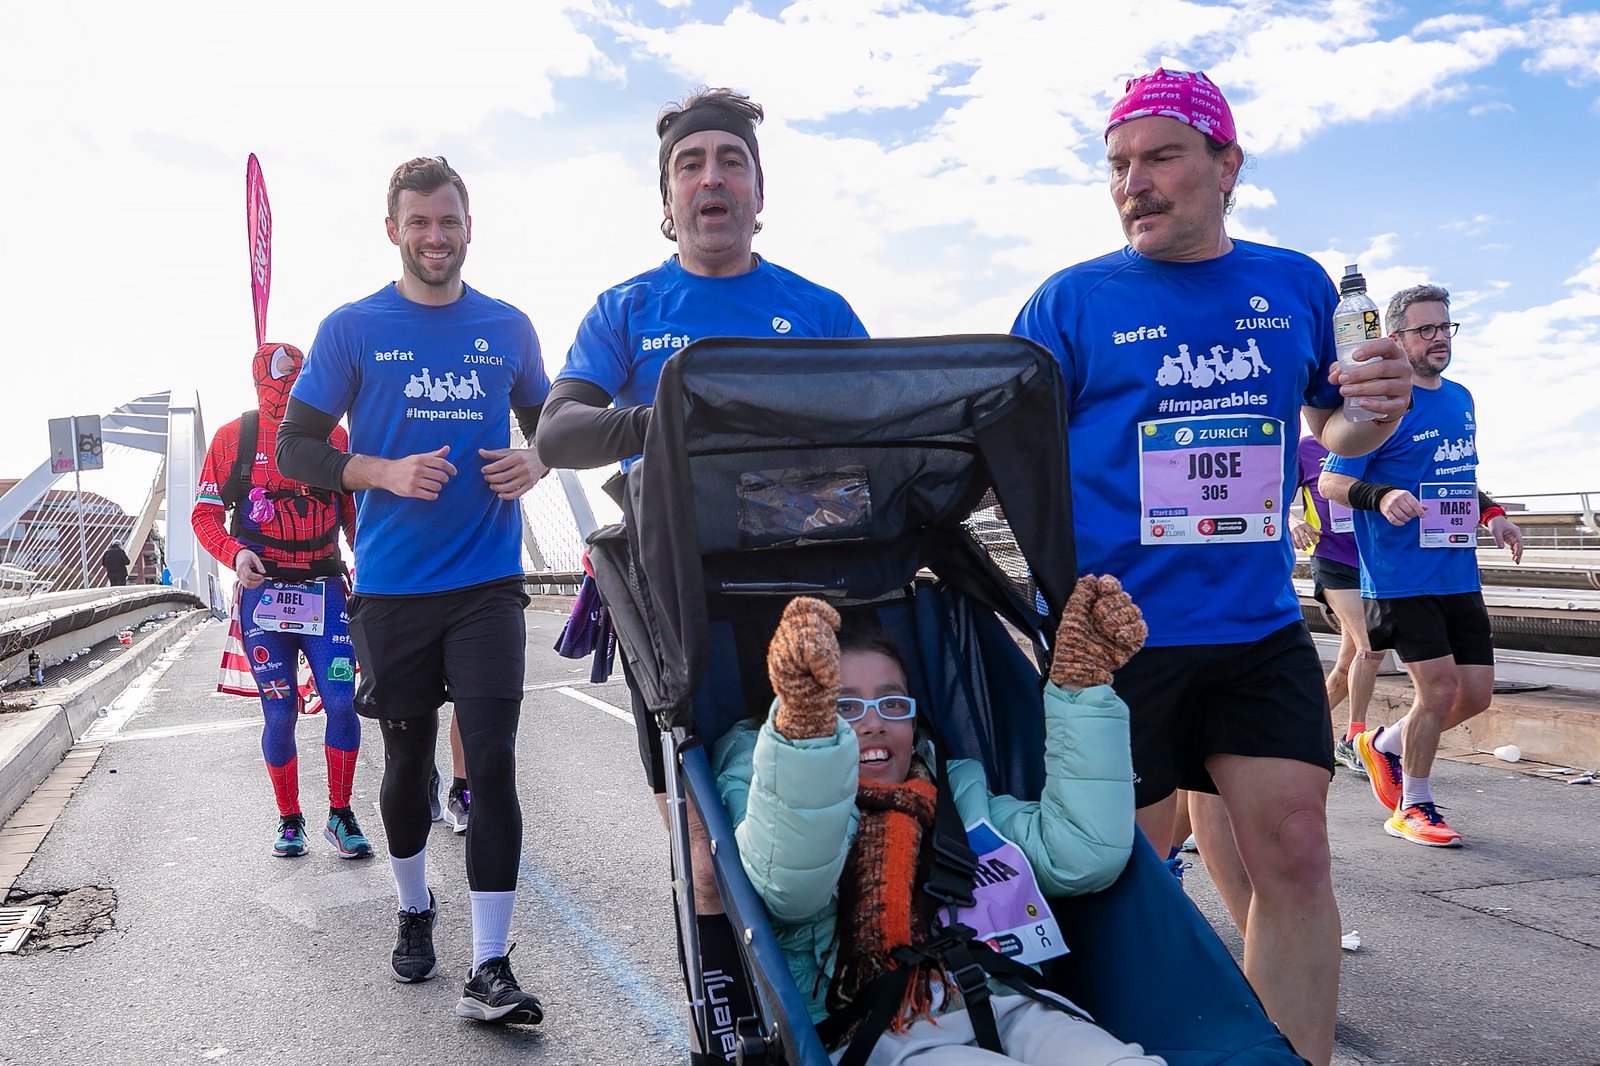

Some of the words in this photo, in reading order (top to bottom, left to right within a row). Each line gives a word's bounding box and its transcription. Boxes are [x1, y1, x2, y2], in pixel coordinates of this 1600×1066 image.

[1142, 91, 1181, 101] aefat
[1235, 317, 1290, 331] ZURICH
[1113, 325, 1168, 345] aefat
[642, 333, 690, 351] aefat
[375, 350, 414, 361] aefat
[463, 355, 503, 366] ZURICH
[1158, 391, 1268, 414] #Imparables
[406, 408, 484, 421] #Imparables
[1199, 428, 1248, 440] ZURICH
[1413, 429, 1440, 442] aefat
[1188, 452, 1241, 480] JOSE
[1202, 485, 1228, 500] 305
[1440, 501, 1471, 515] MARC
[1450, 518, 1463, 526] 493
[276, 592, 304, 606] ABEL
[282, 606, 296, 615] 482
